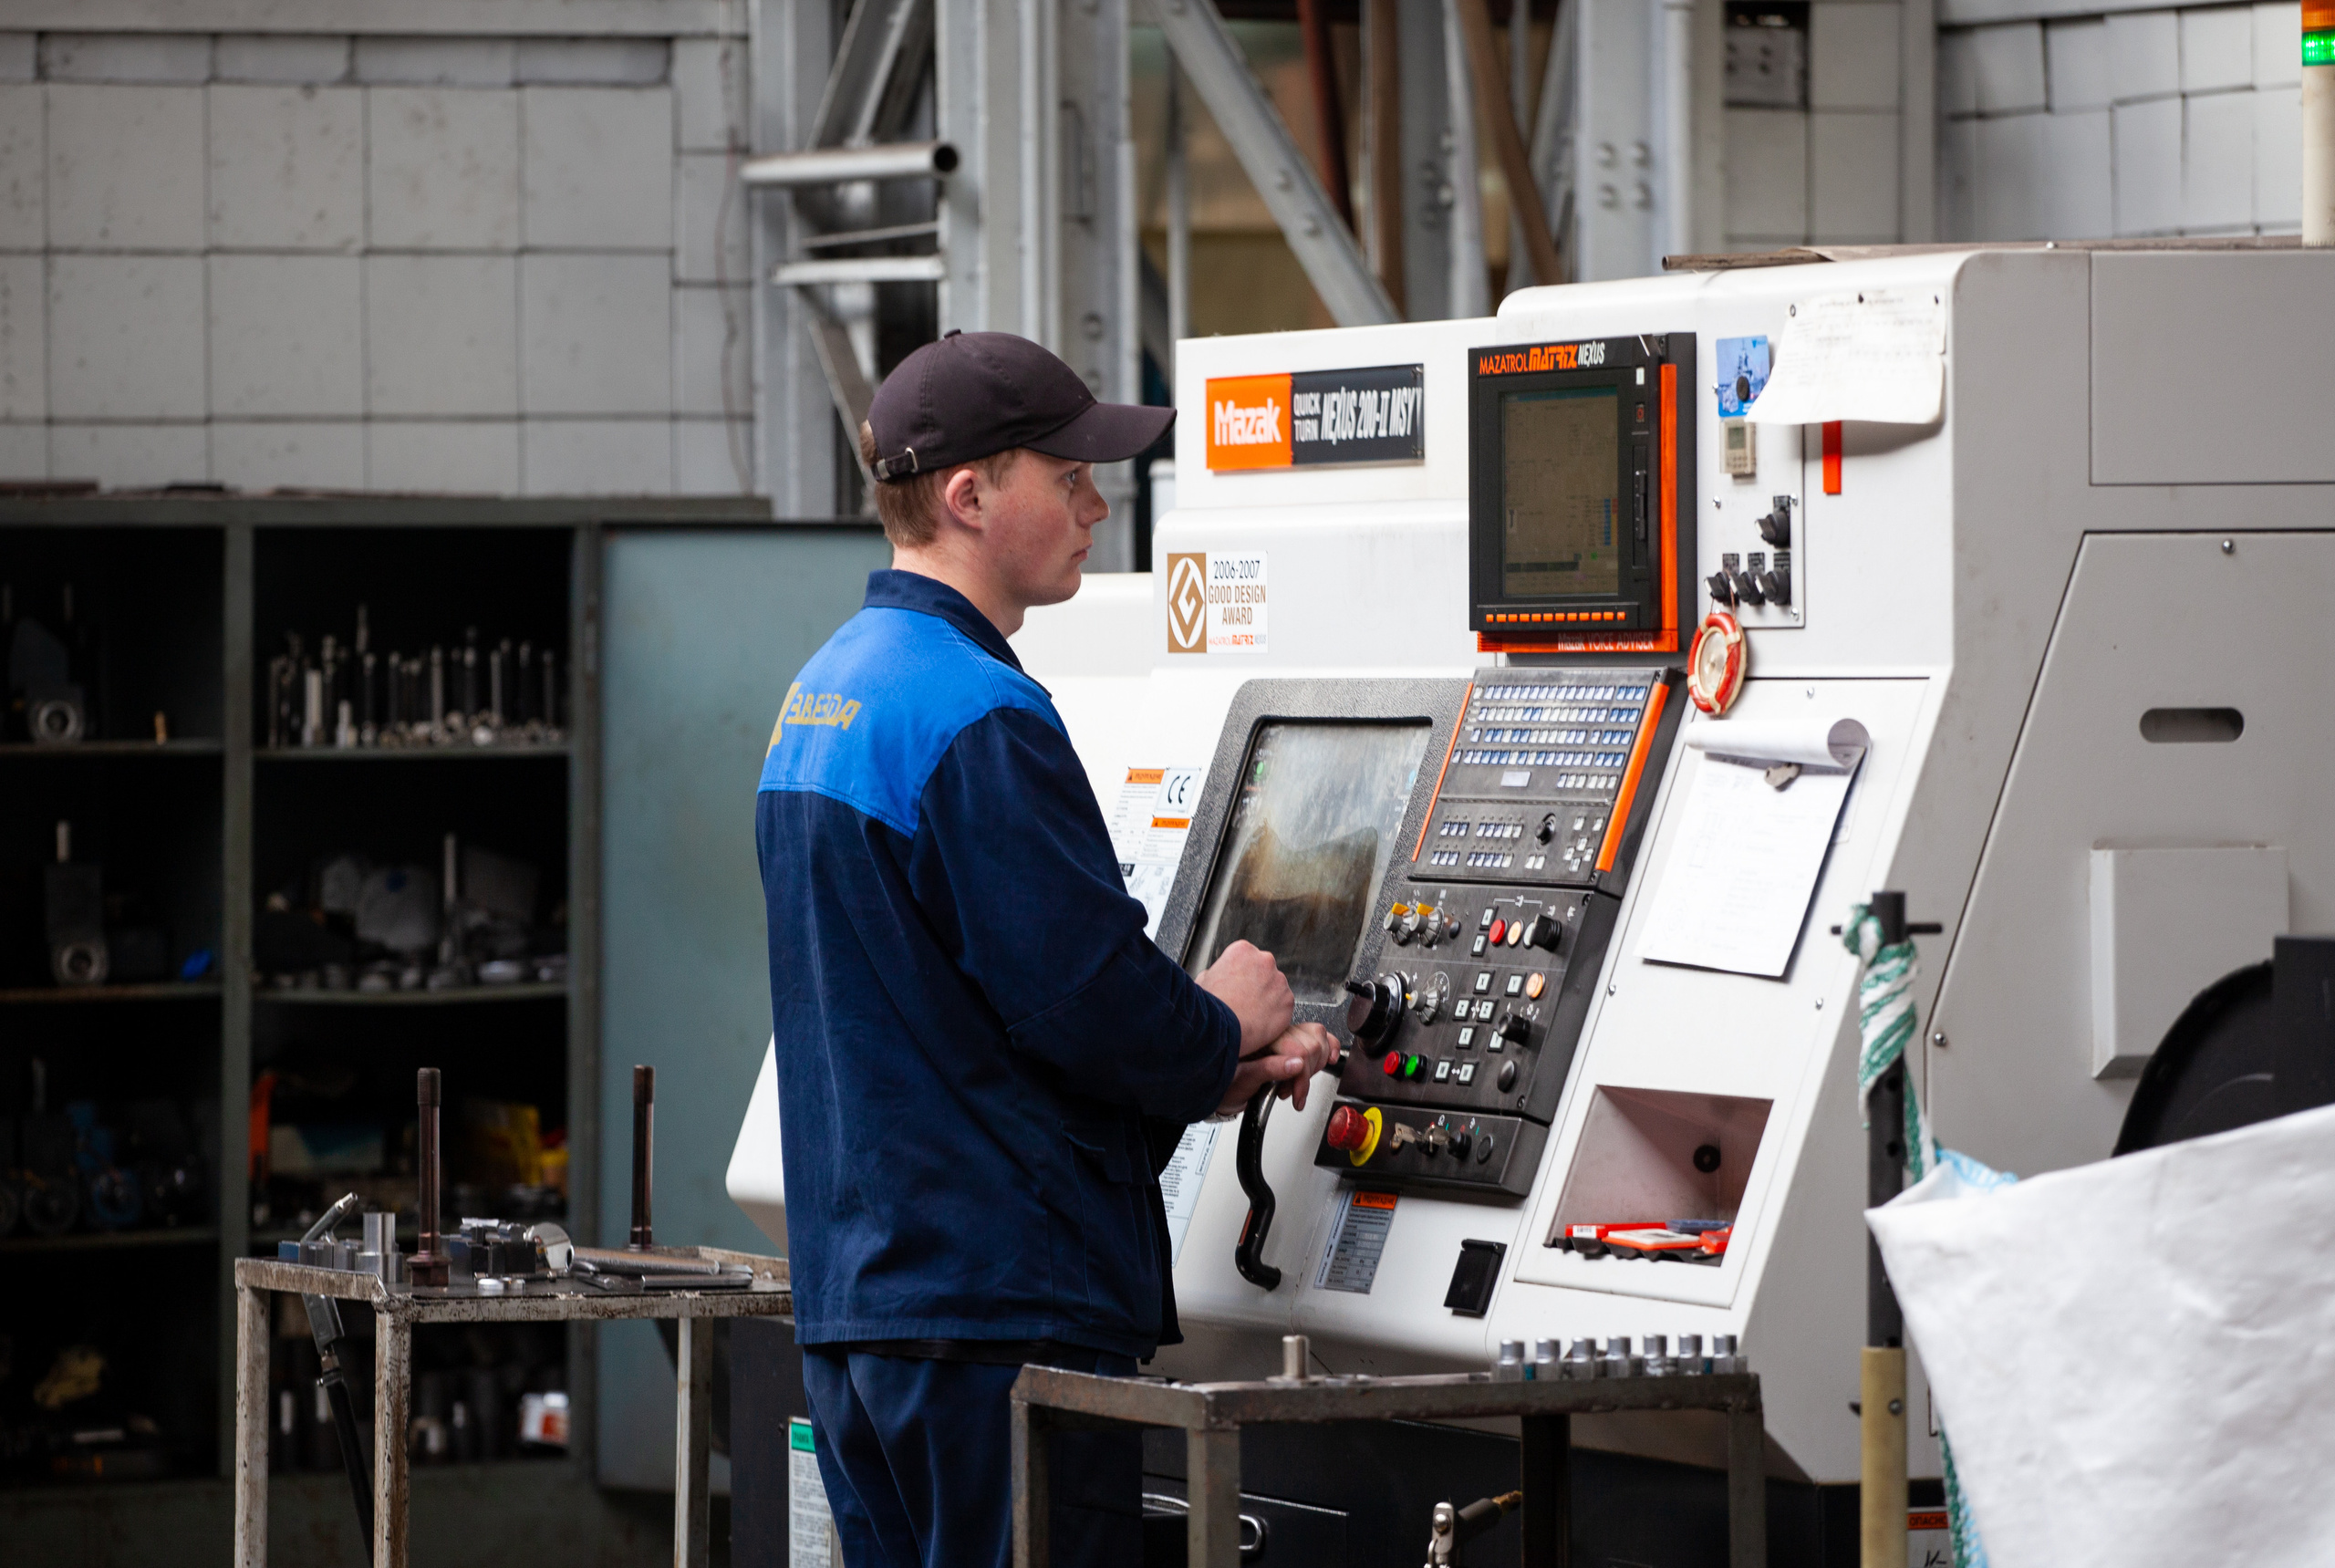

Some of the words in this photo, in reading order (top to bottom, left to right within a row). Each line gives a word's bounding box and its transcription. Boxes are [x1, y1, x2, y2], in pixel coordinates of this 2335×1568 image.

[1479, 353, 1528, 375] MAZATROL
[1528, 344, 1579, 372] MATRIX
[1578, 340, 1605, 368] NEXUS
[1293, 392, 1321, 417] QUICK
[1321, 386, 1358, 445] NEXUS
[1214, 397, 1282, 446] Mazak
[1293, 419, 1319, 442] TURN
[1213, 560, 1261, 579] 2006-2007
[1209, 585, 1232, 604] GOOD
[1235, 585, 1266, 604] DESIGN
[1222, 607, 1253, 625] AWARD
[1558, 632, 1586, 650] Mazak
[1587, 632, 1614, 650] VOICE
[1616, 632, 1655, 650] ADVISER
